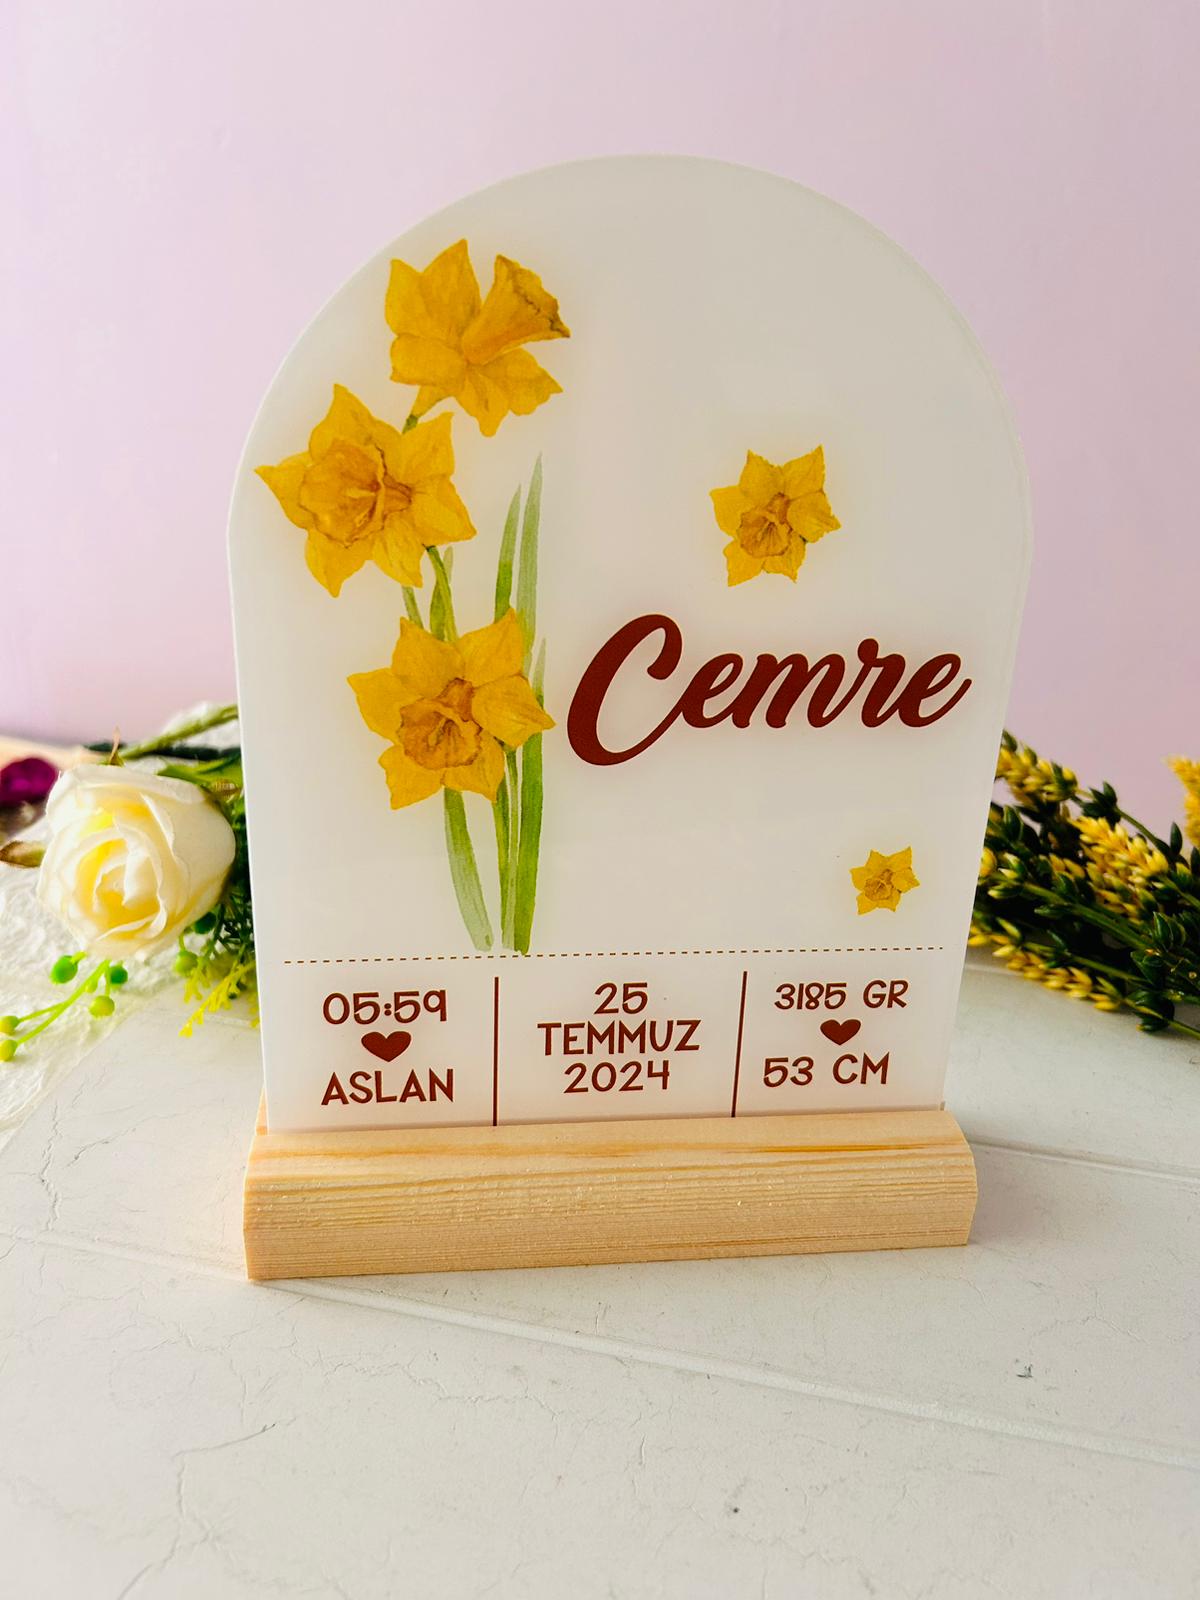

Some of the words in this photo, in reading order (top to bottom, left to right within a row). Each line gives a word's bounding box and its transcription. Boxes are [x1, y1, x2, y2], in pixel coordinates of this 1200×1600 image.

[567, 613, 972, 767] Cemre
[322, 989, 447, 1025] 05:59
[593, 981, 649, 1015] 25
[774, 982, 847, 1011] 3185
[862, 979, 909, 1009] GR
[536, 1019, 702, 1057] TEMMUZ
[320, 1067, 455, 1106] ASLAN
[563, 1059, 670, 1094] 2024
[763, 1056, 815, 1088] 53
[832, 1052, 890, 1086] CM
